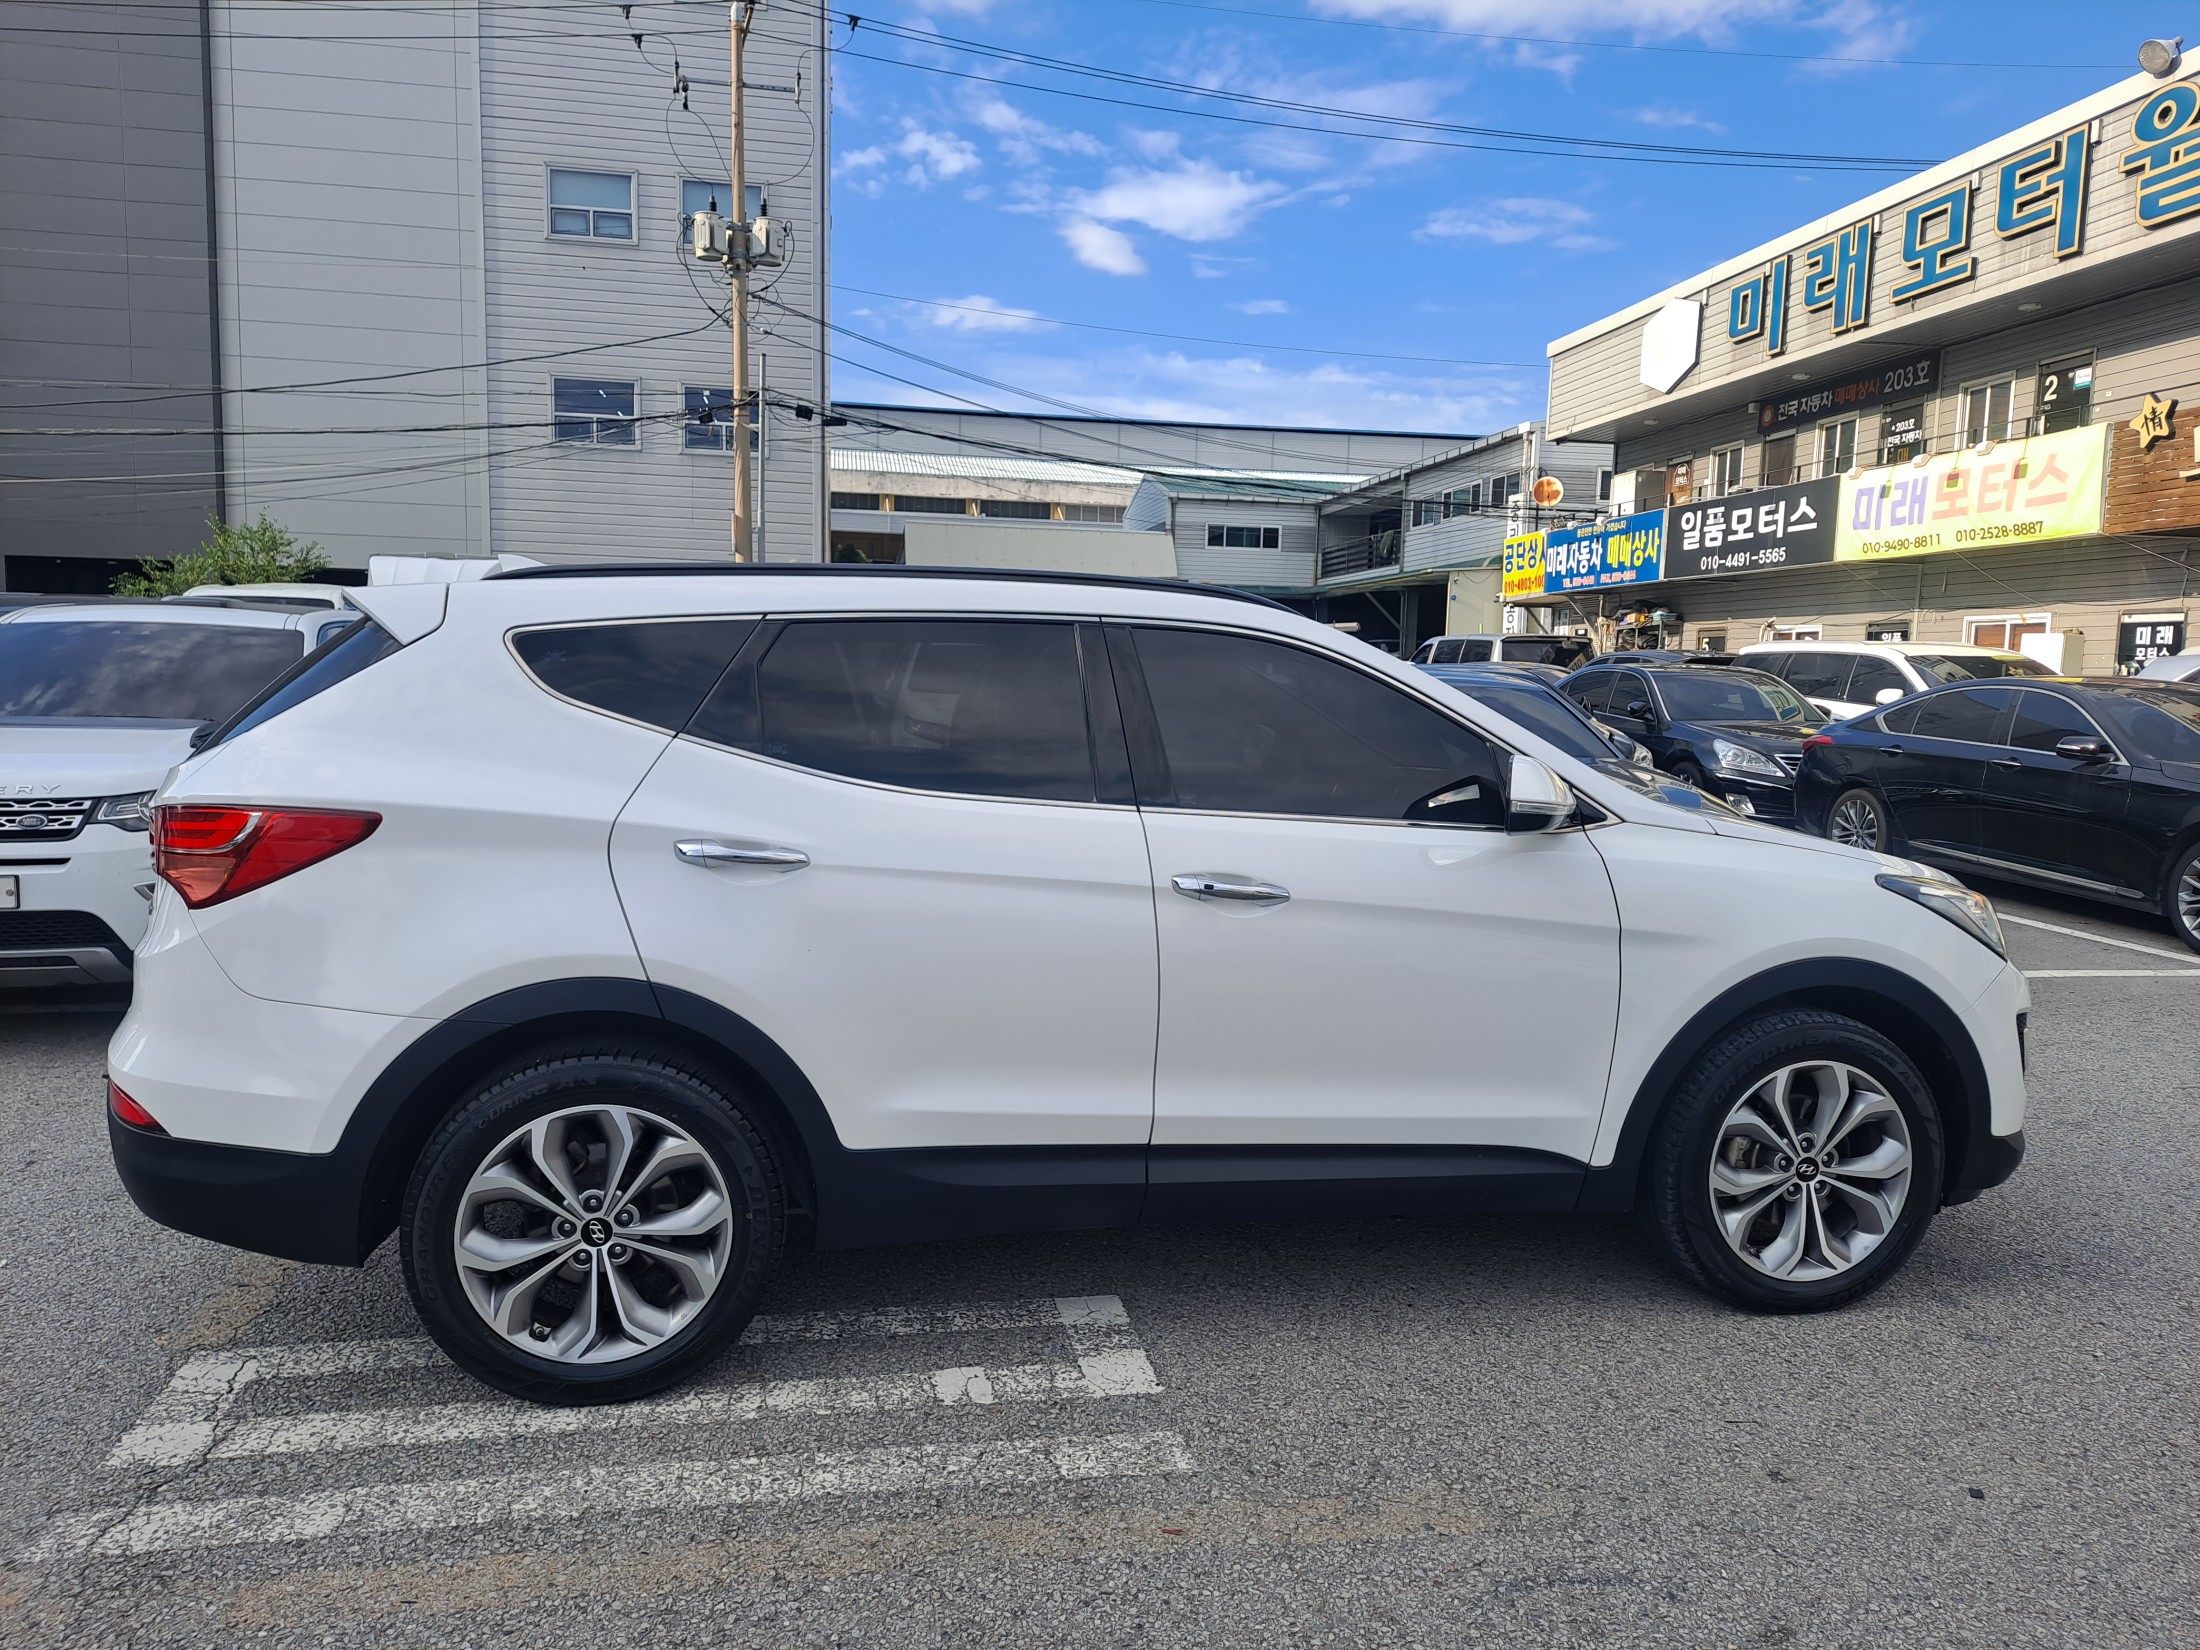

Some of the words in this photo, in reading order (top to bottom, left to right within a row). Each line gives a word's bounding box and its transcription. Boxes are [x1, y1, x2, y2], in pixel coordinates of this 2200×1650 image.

[1778, 399, 1798, 421] 전국
[1800, 390, 1833, 414] 자동차
[1835, 378, 1881, 406] 매매상사
[1883, 360, 1931, 394] 203호
[2043, 374, 2059, 402] 2
[1896, 418, 1915, 432] 203호
[2140, 405, 2163, 436] 情
[1887, 434, 1901, 447] 전국
[1901, 429, 1922, 443] 자동차
[1680, 496, 1818, 551] 일품모터스
[1862, 533, 1941, 554] 010-9490-8811
[1956, 521, 2044, 543] 010-2528-8887
[1547, 538, 1603, 577] 미래자동차
[1607, 527, 1660, 569] 매매상사
[1701, 547, 1787, 571] 010-4491-5565
[2135, 625, 2174, 645] 미래
